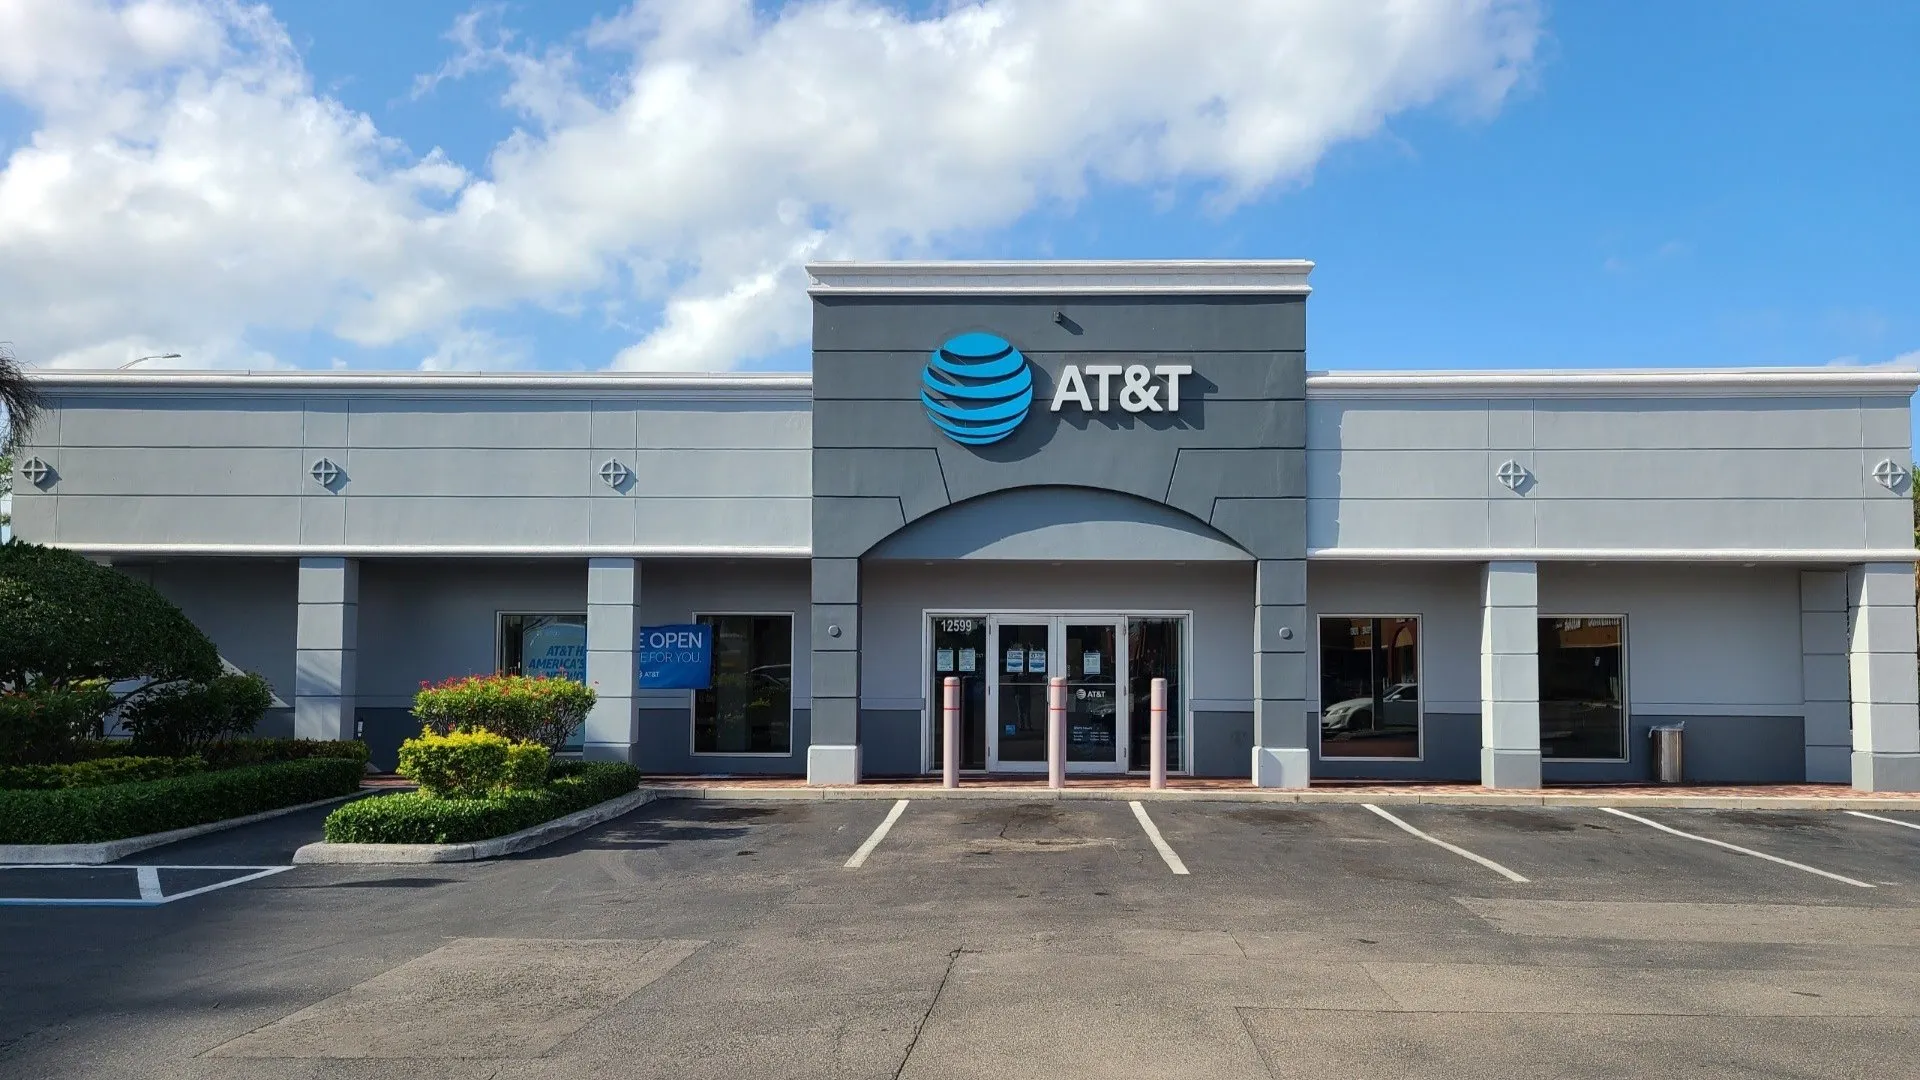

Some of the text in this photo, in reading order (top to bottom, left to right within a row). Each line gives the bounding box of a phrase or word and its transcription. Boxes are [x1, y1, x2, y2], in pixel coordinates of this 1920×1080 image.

[1050, 364, 1192, 412] AT&T
[941, 619, 972, 632] 12599
[640, 632, 702, 648] E OPEN
[546, 645, 585, 657] AT&T H
[528, 658, 584, 669] AMERICA'S
[640, 652, 702, 663] E FOR YOU.
[1087, 690, 1106, 698] AT&T
